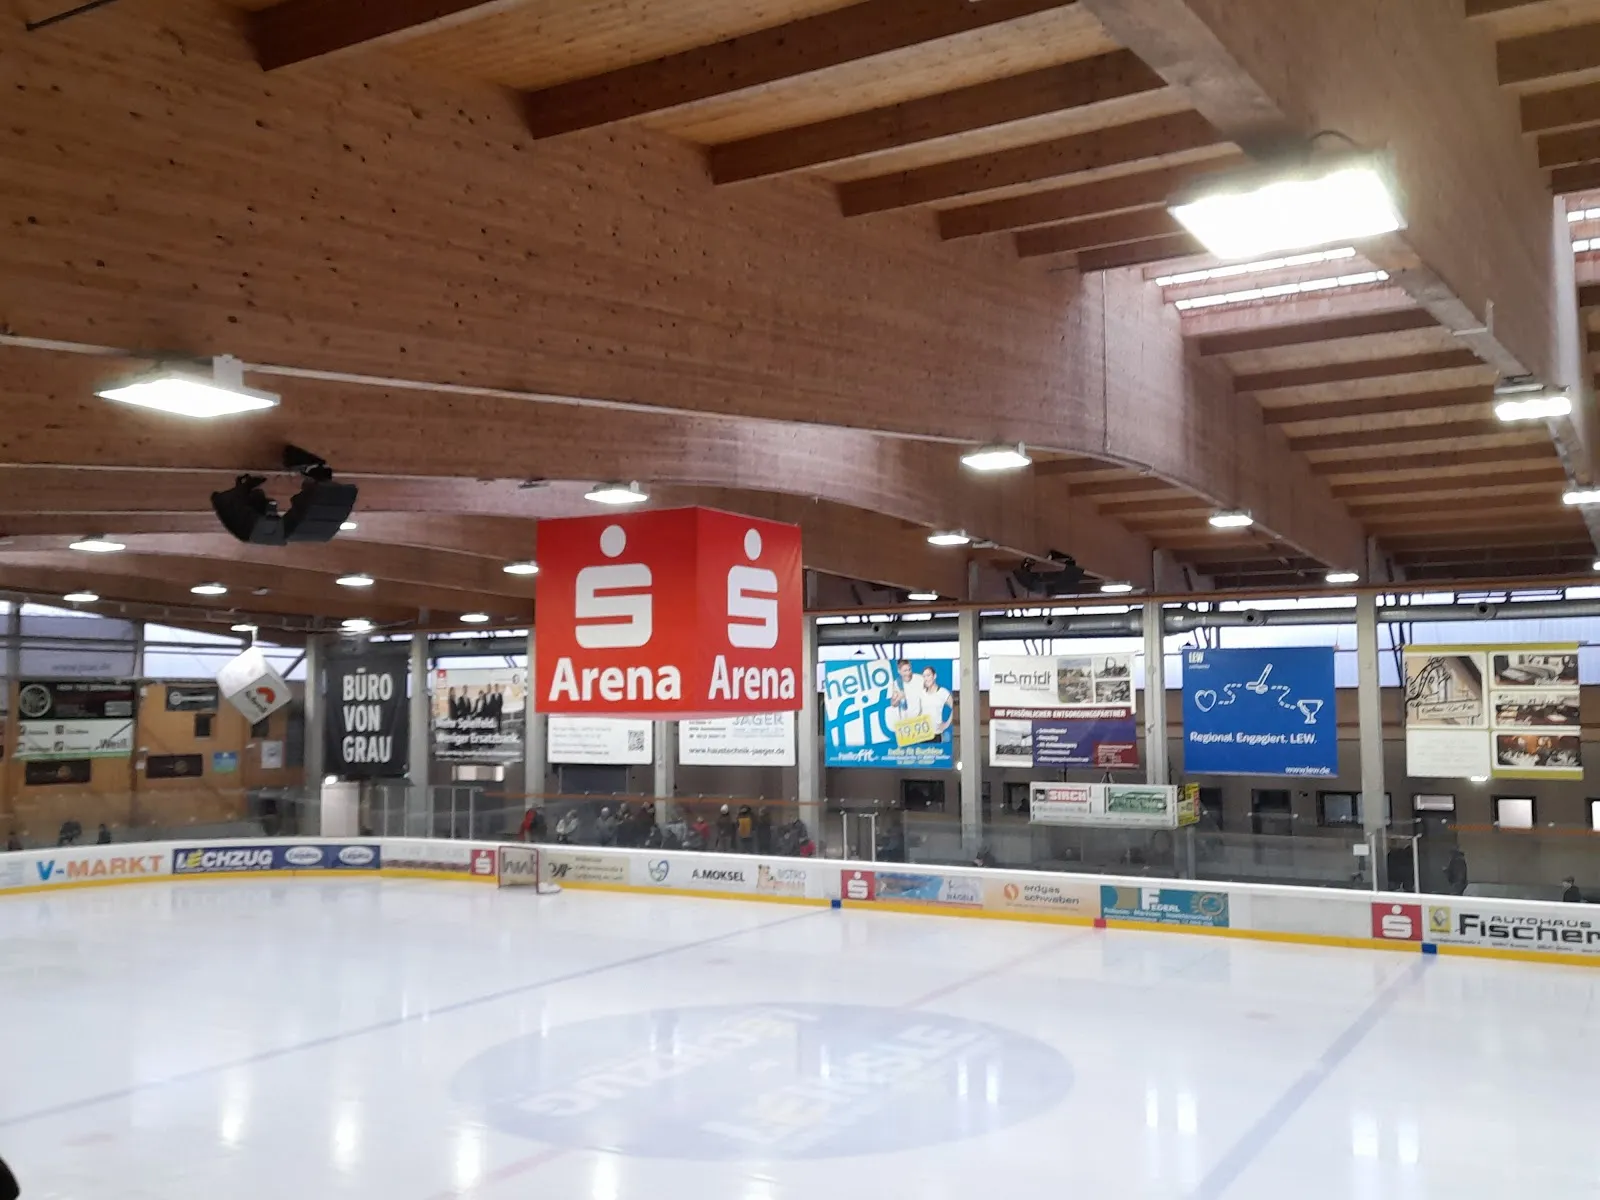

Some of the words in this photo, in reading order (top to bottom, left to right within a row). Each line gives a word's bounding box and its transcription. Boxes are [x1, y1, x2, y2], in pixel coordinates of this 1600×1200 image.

[342, 667, 393, 701] BÜRO
[548, 657, 682, 702] Arena
[708, 654, 795, 701] Arena
[825, 663, 890, 700] hello
[343, 704, 381, 733] VON
[826, 689, 896, 748] fit
[342, 736, 392, 763] GRAU
[688, 746, 786, 756] www.haustechnik-jaeger.de
[1190, 731, 1235, 744] Regional.
[1236, 732, 1289, 746] Engagiert.
[1289, 733, 1318, 744] LEW.
[36, 854, 164, 881] V-MARKT
[1024, 883, 1060, 895] erdgas
[1024, 894, 1080, 905] schwaben
[1458, 913, 1600, 945] Fischer
[1490, 915, 1592, 928] AUTOHAUS
